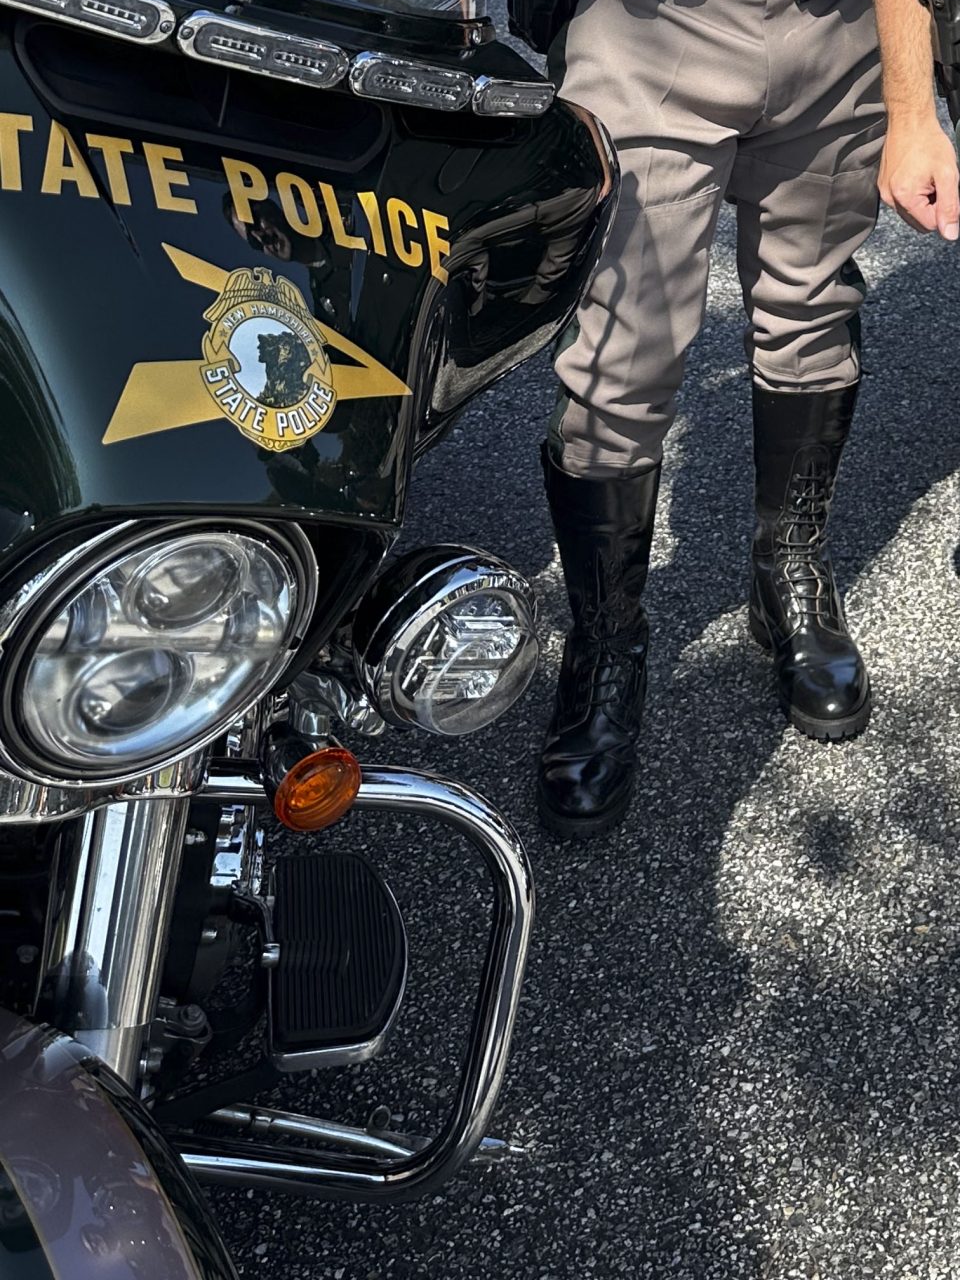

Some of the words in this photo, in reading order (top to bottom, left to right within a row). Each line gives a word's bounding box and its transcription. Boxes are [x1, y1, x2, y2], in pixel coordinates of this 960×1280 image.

[221, 156, 450, 286] POLICE
[222, 307, 246, 330] NEW
[250, 304, 315, 348] HAMPSHIRE
[206, 366, 267, 433] STATE
[276, 382, 334, 437] POLICE
